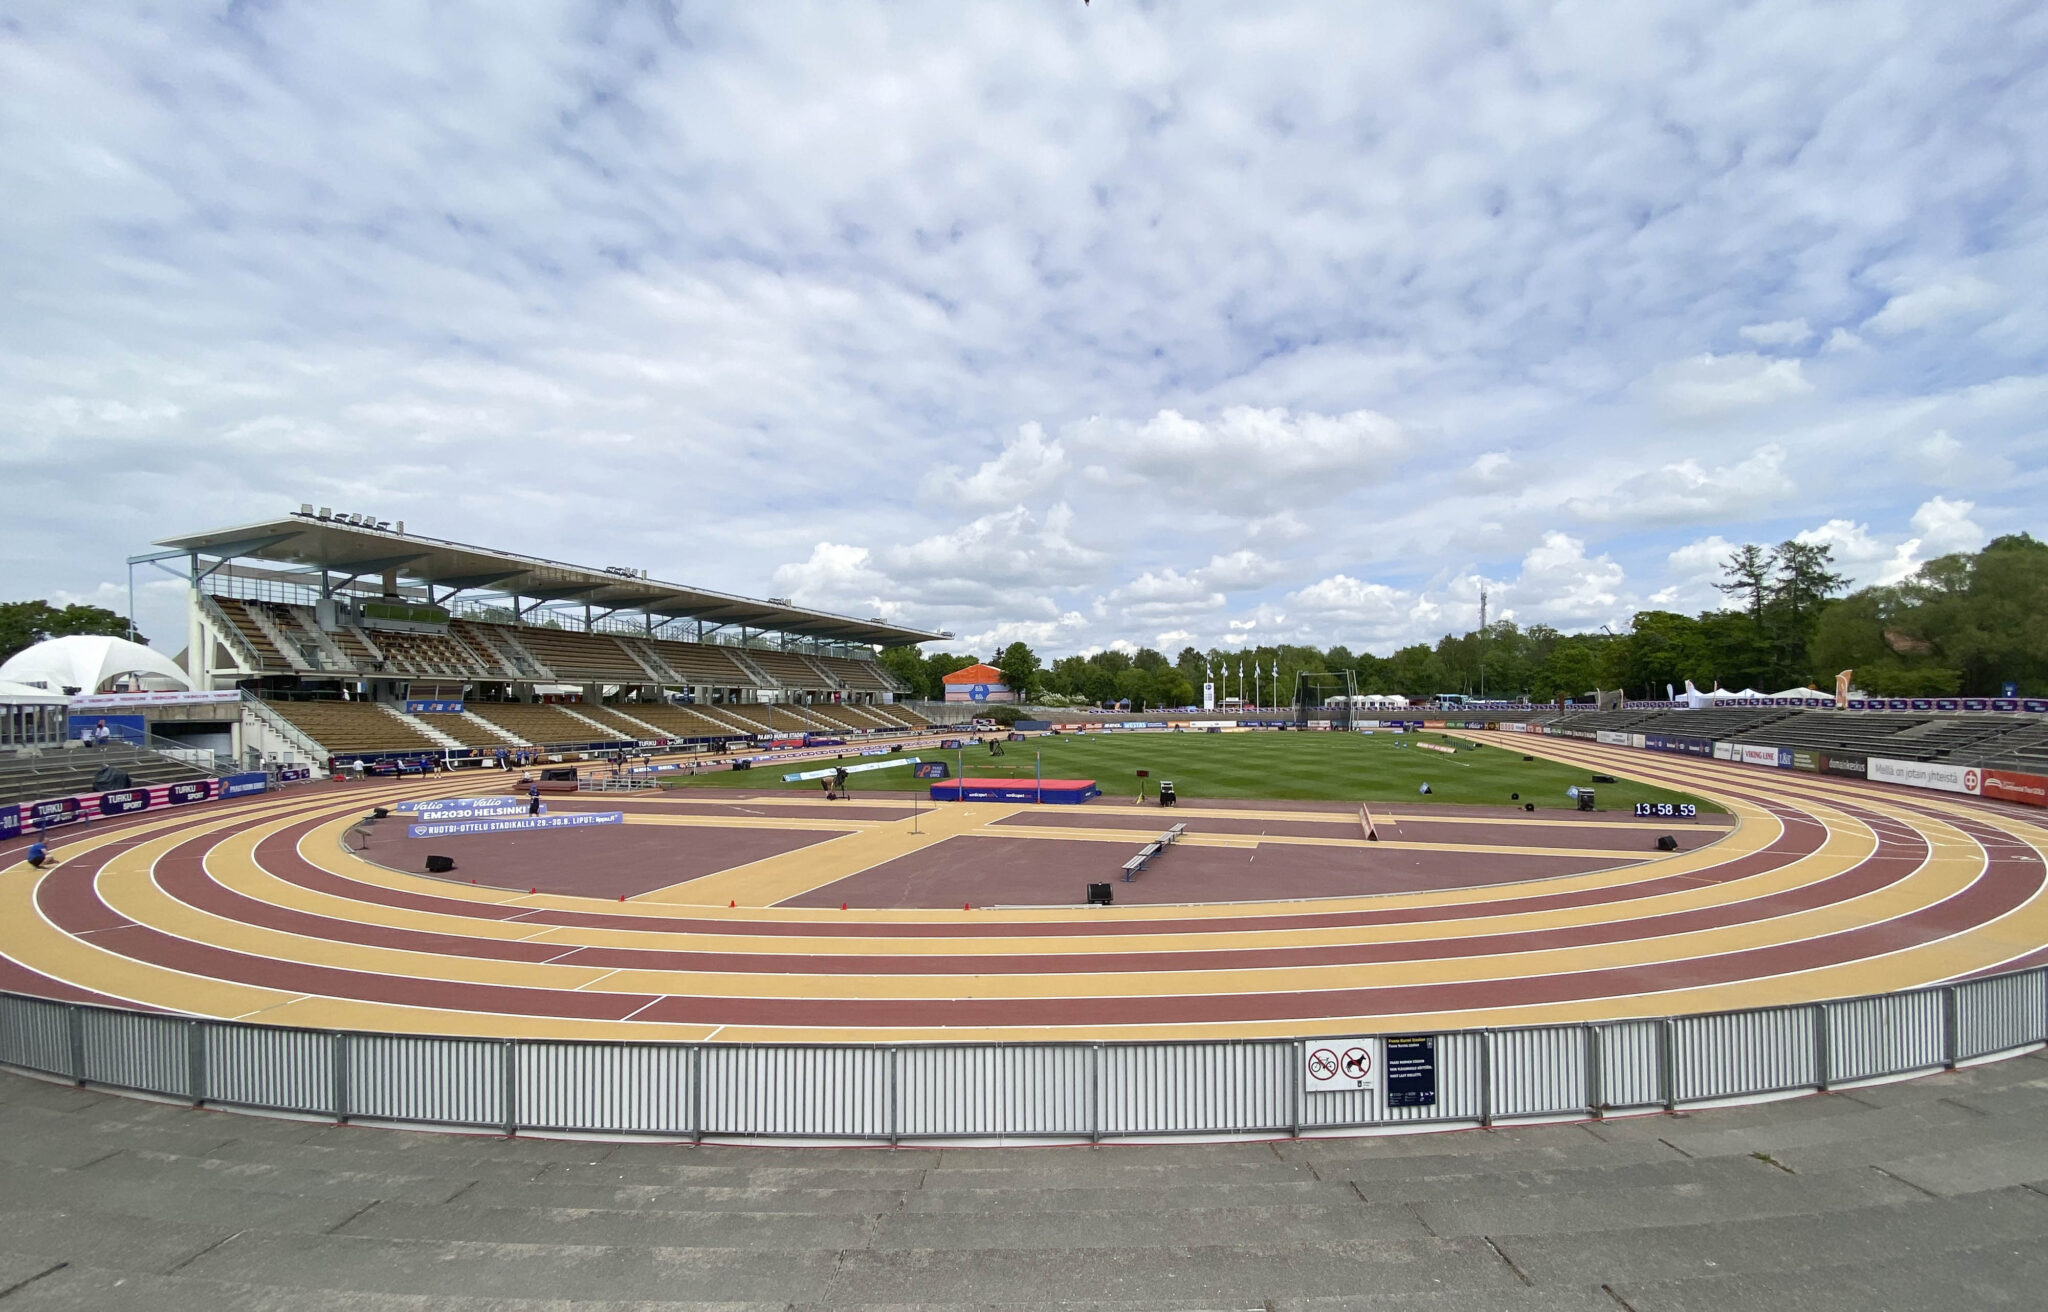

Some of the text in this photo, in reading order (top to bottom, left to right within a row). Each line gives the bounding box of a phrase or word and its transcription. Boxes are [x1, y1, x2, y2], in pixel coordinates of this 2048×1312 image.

[1745, 750, 1763, 760] VIKING
[1763, 752, 1775, 760] LINE
[1905, 767, 1927, 780] jotain
[175, 785, 196, 794] TURKU
[108, 793, 132, 803] TURKU
[187, 792, 205, 800] SPORT
[122, 800, 143, 810] SPORT
[412, 801, 444, 811] Valio
[472, 798, 502, 807] Valio
[38, 803, 63, 815] TURKU
[423, 806, 527, 820] EM2030 HELSINKI
[1635, 803, 1696, 816] 13:58.59
[428, 823, 489, 834] RUOTSI-OTTELU
[490, 819, 535, 830] STADIKALLA
